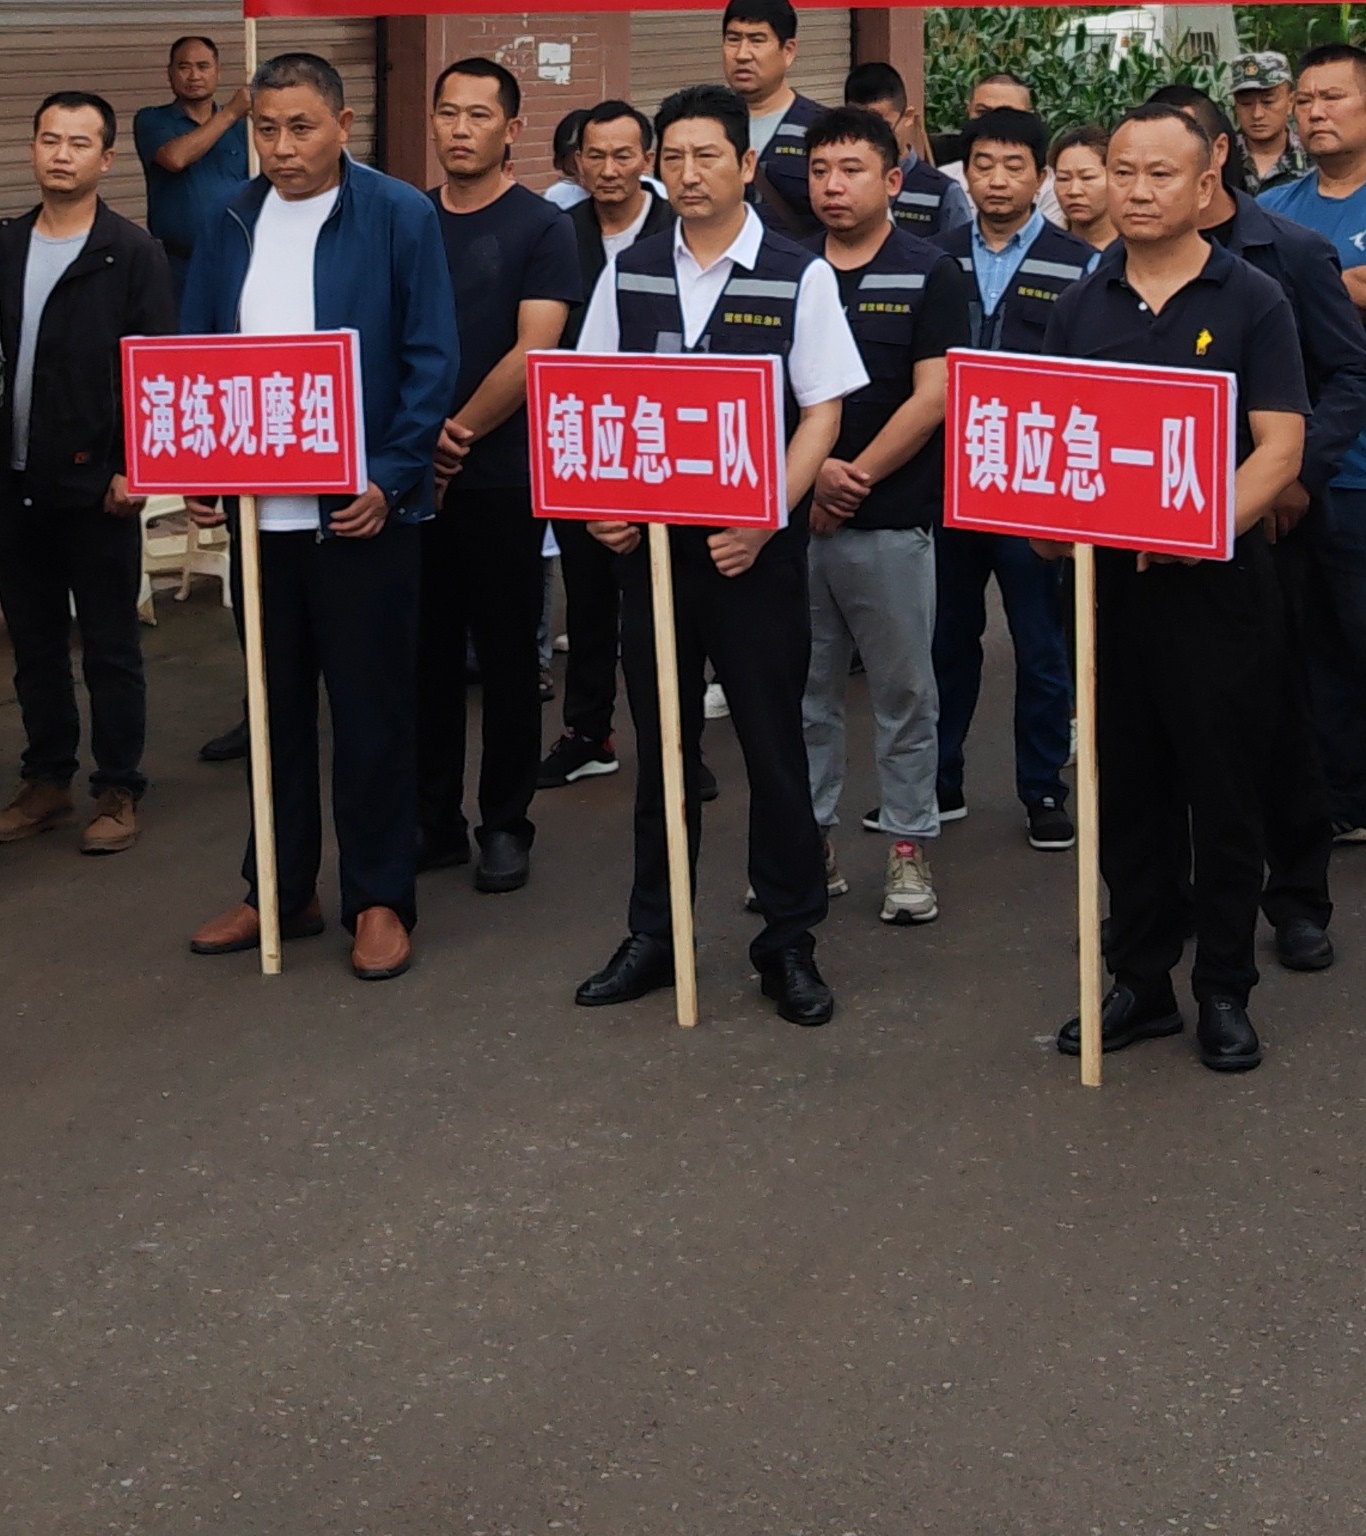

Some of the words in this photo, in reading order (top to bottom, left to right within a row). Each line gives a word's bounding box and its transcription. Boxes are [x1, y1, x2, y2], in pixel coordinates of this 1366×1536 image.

[140, 371, 339, 458] 演练观摩组
[547, 393, 759, 488] 镇应急二队
[965, 395, 1207, 515] 镇应急一队
